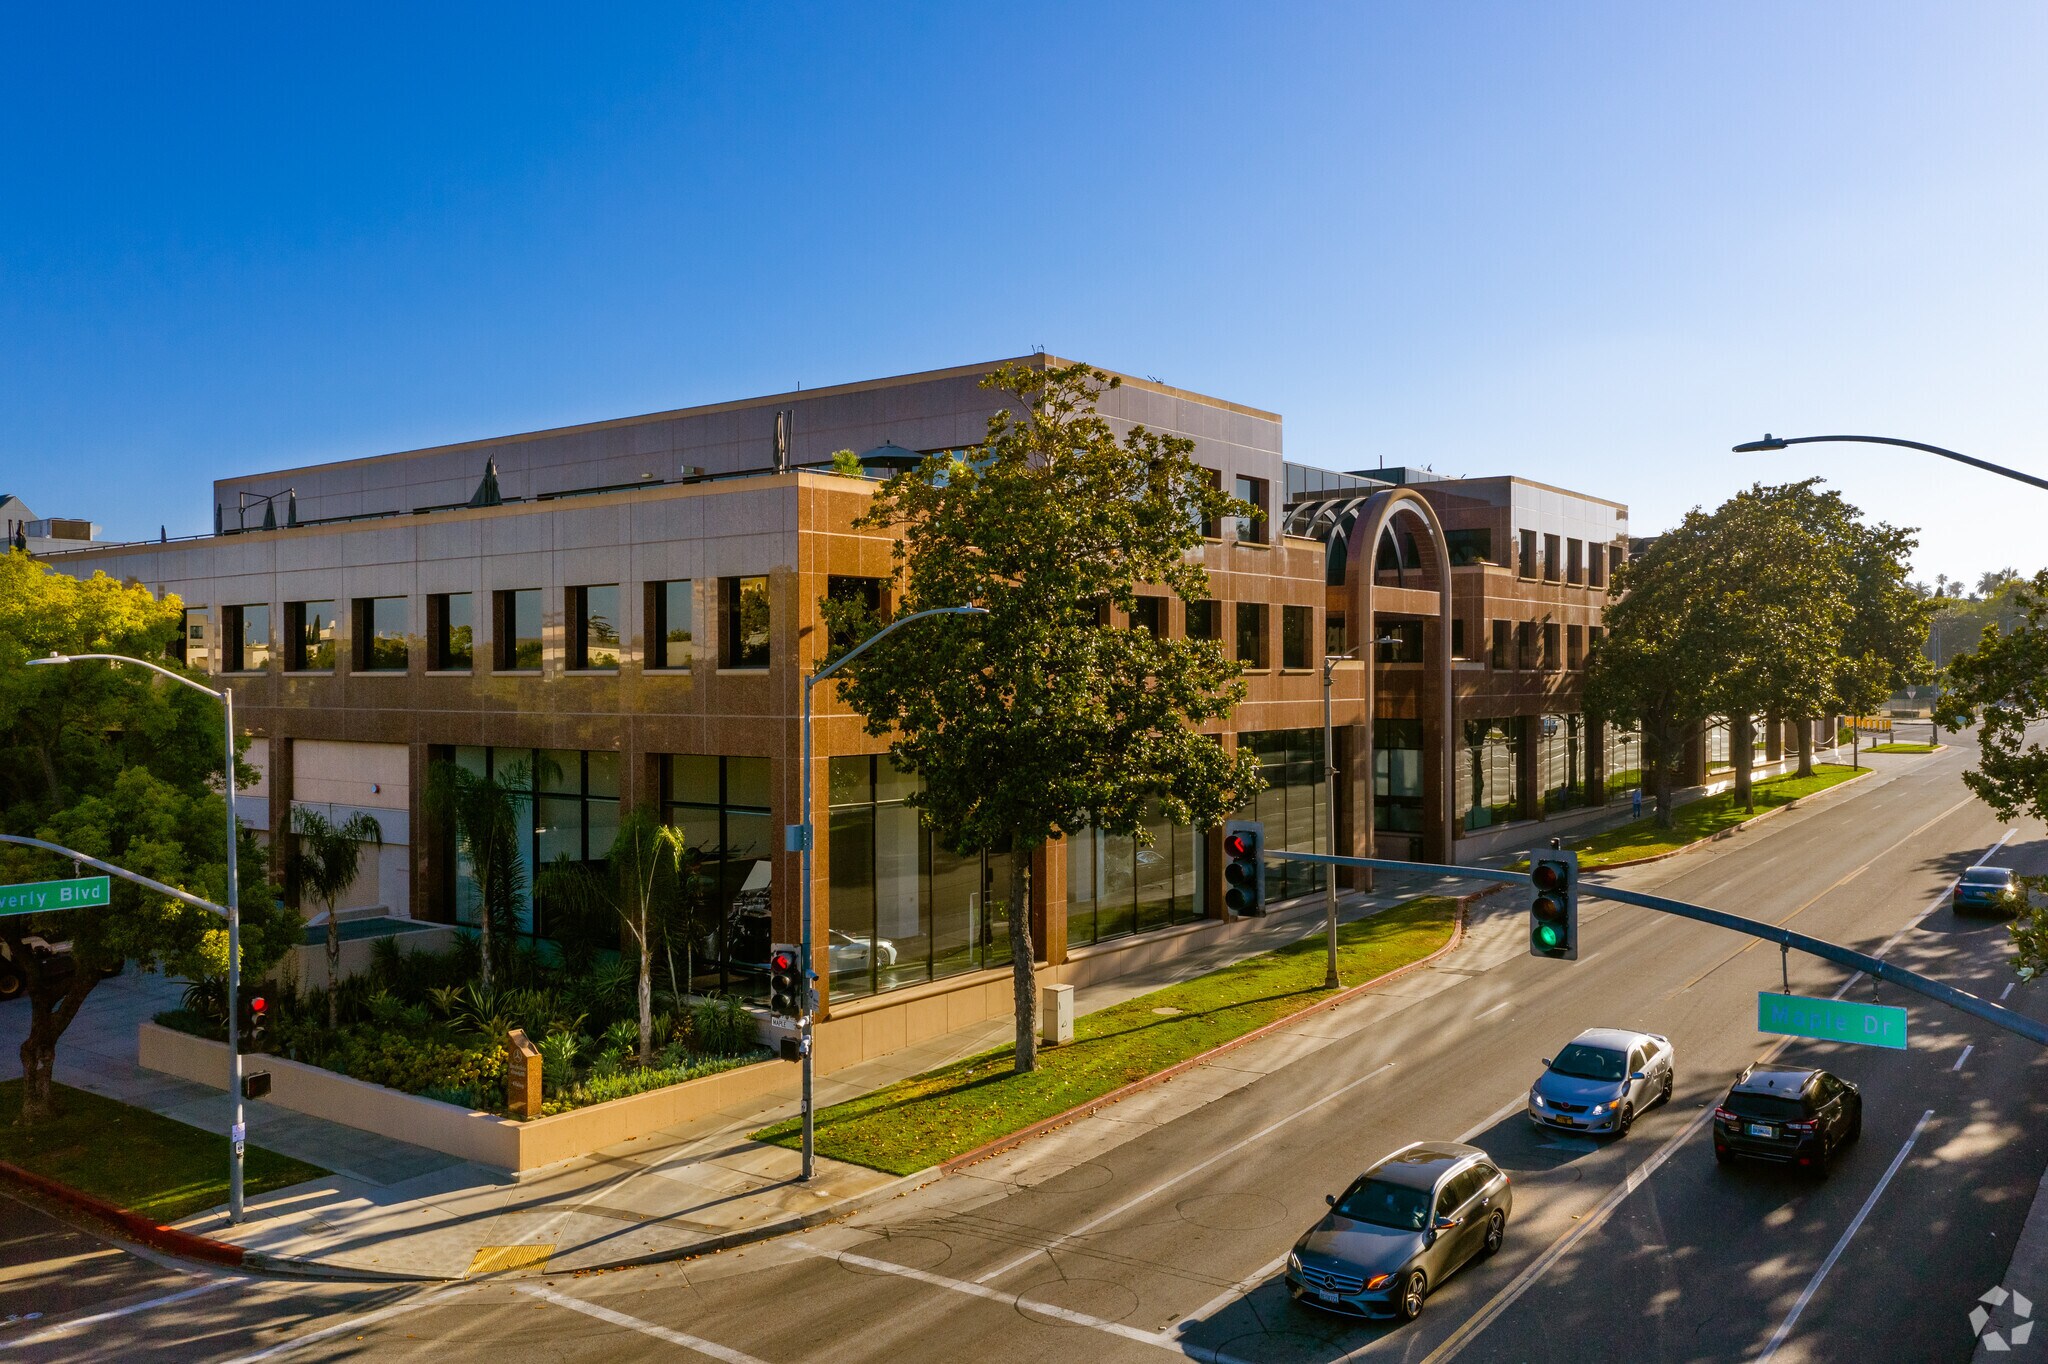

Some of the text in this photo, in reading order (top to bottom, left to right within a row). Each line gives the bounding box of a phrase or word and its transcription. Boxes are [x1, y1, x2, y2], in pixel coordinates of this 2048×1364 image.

[0, 885, 100, 908] verly Blvd
[773, 1019, 787, 1028] MAPLE
[1771, 1005, 1892, 1036] Maple Dr
